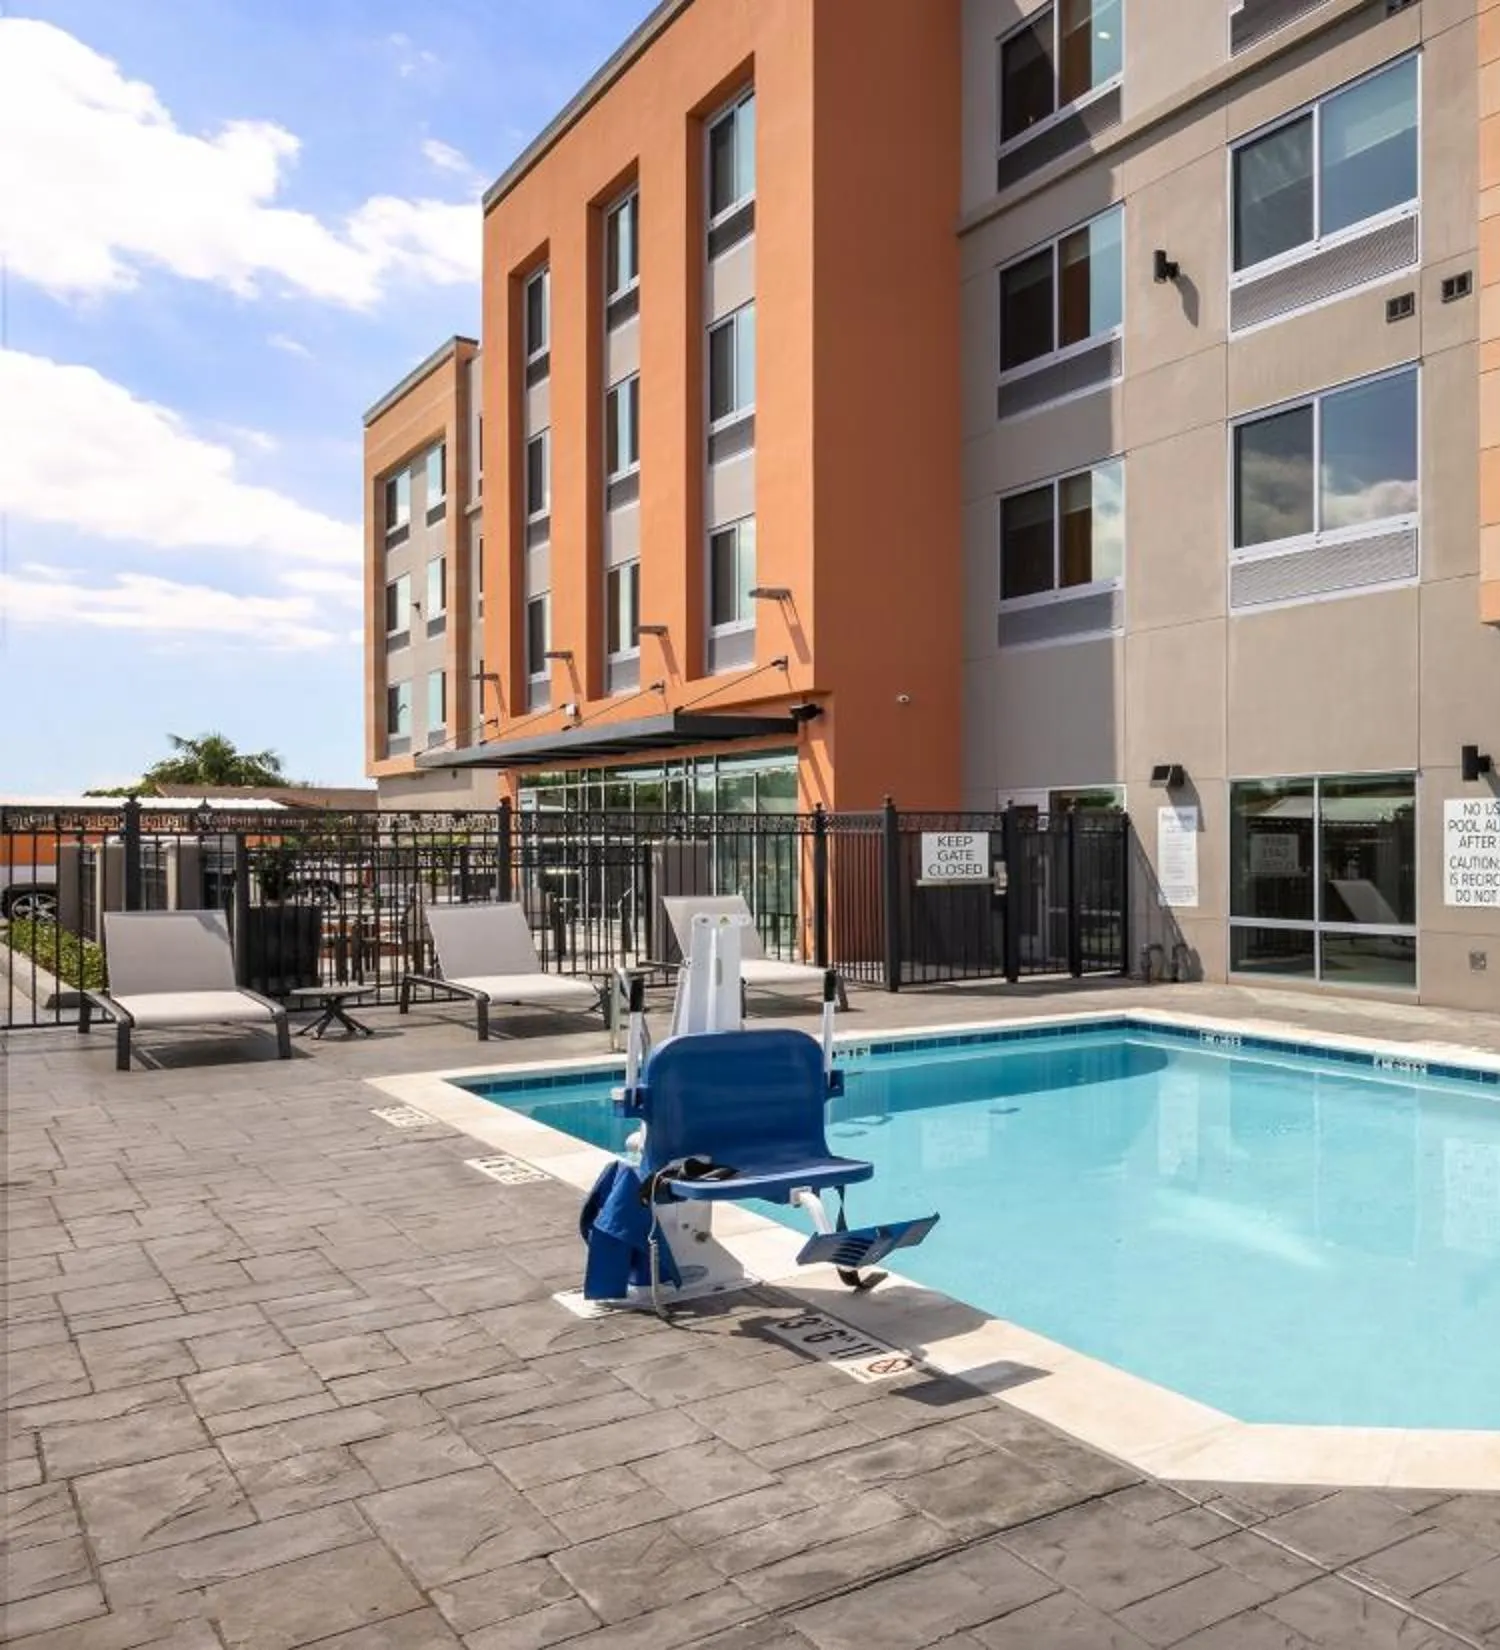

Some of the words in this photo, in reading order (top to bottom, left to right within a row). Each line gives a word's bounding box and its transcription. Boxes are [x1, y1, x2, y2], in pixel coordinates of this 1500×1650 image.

[1463, 802, 1482, 816] NO
[1448, 819, 1482, 833] POOL
[937, 835, 974, 847] KEEP
[1458, 835, 1497, 849] AFTER
[937, 849, 975, 862] GATE
[928, 863, 983, 876] CLOSED
[1449, 856, 1500, 870] CAUTION:
[1450, 873, 1459, 885] IS
[1456, 890, 1470, 903] DO
[1474, 891, 1497, 904] NOT
